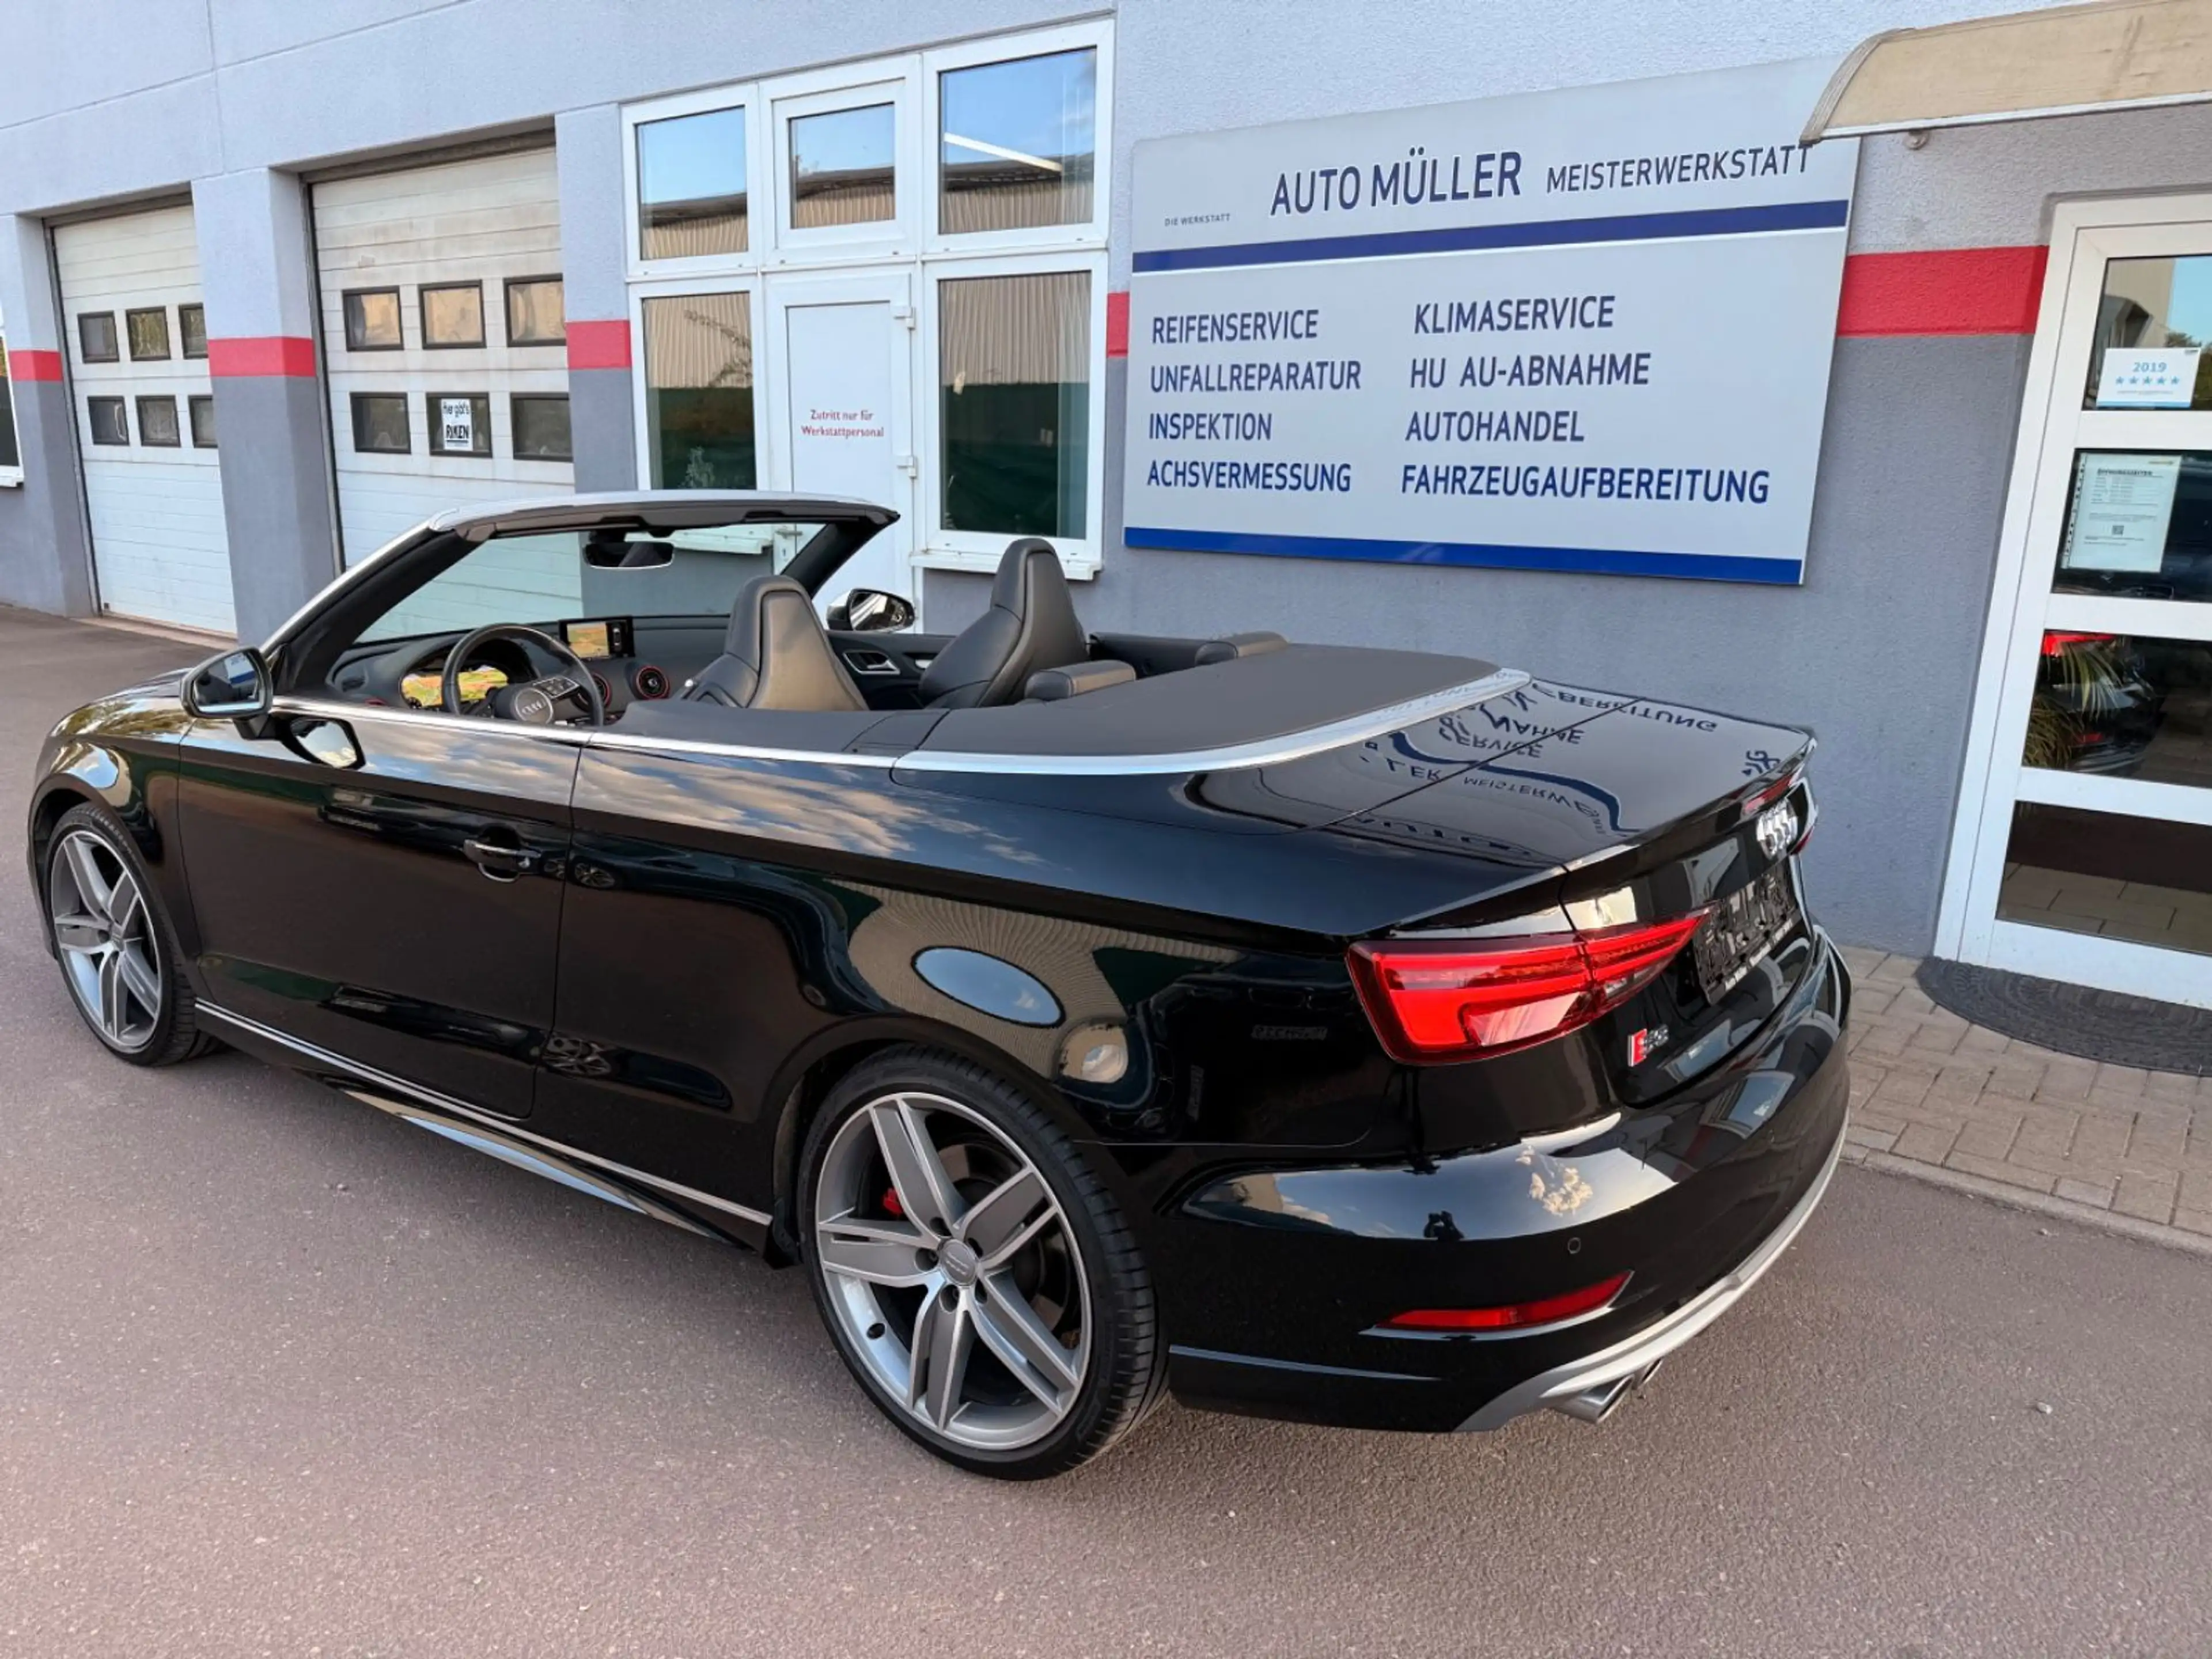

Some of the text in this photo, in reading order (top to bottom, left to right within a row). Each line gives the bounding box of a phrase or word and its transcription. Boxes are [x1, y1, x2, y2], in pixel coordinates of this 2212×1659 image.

[1270, 146, 1522, 217] AUTO MÜLLER
[1547, 144, 1813, 194] MEISTERWERKSTATT
[1164, 213, 1230, 227] DIE WERKSTATT
[1152, 309, 1320, 344] REIFENSERVICE
[1414, 294, 1616, 335] KLIMASERVICE
[1150, 360, 1362, 393] UNFALLREPARATUR
[1410, 352, 1652, 389] HU AU-ABNAHME
[2133, 362, 2168, 373] 2019
[810, 409, 874, 421] Zutritt nur für
[1149, 412, 1272, 441] INSPEKTION
[1404, 410, 1585, 442] AUTOHANDEL
[801, 426, 885, 439] Werkstattpersonal
[1146, 459, 1351, 493] ACHSVERMESSUNG
[1401, 464, 1770, 505] FAHRZEUGAUFBEREITUNG
